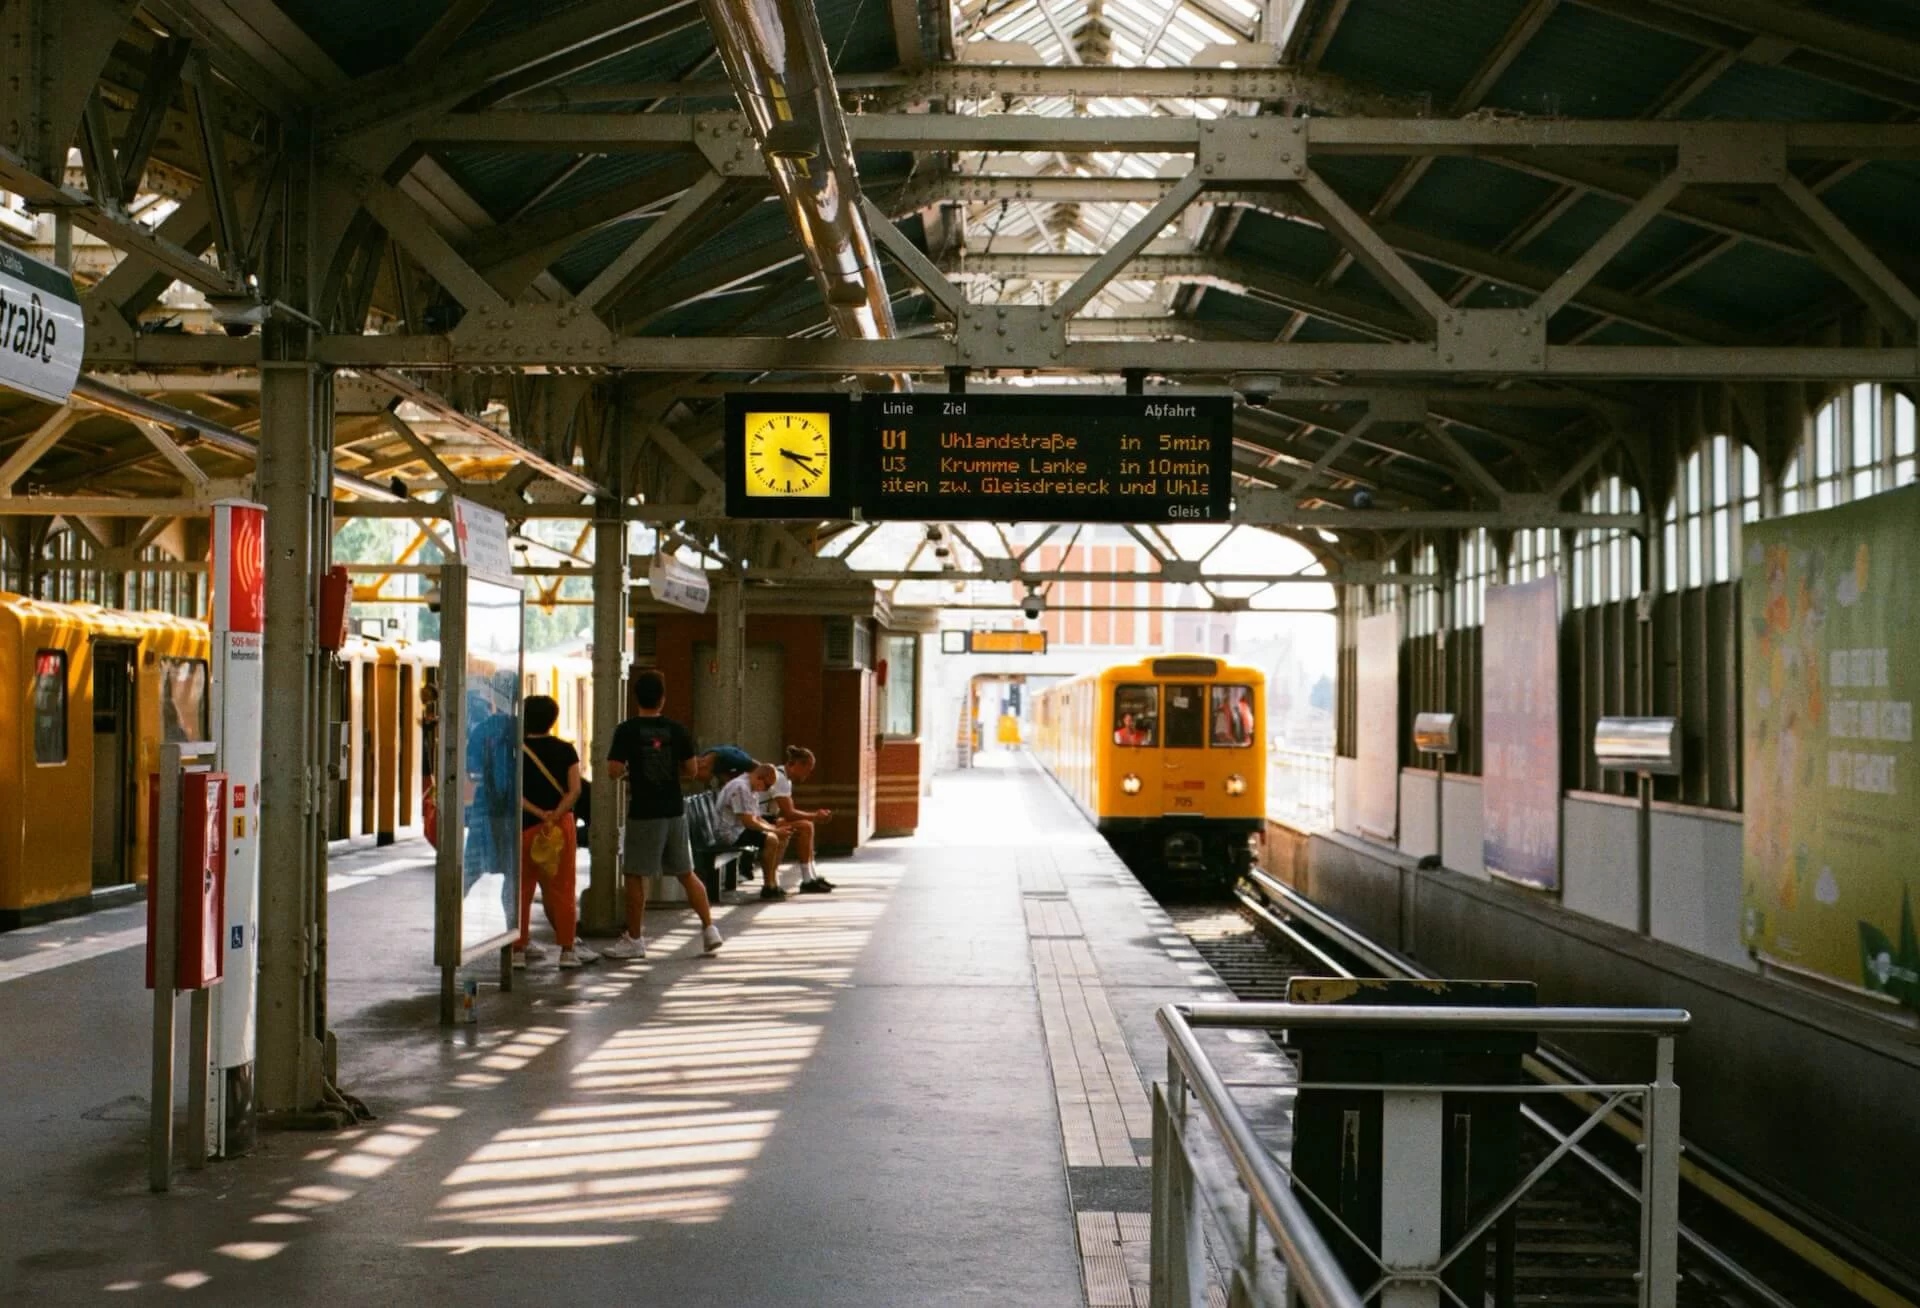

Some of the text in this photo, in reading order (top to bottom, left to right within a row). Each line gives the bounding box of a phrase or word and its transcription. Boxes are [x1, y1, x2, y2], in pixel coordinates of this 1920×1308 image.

[883, 402, 914, 415] Linie
[943, 402, 967, 415] Ziel
[1145, 404, 1196, 419] Abfahrt
[882, 430, 1210, 453] U1 Uhlandstraße in 5min
[882, 456, 1209, 474] U3 Krumme Lanke in 10min
[939, 481, 971, 494] zw.
[981, 477, 1110, 494] Gleisdreieck
[1120, 479, 1156, 495] und
[1168, 504, 1211, 518] Gleis 1
